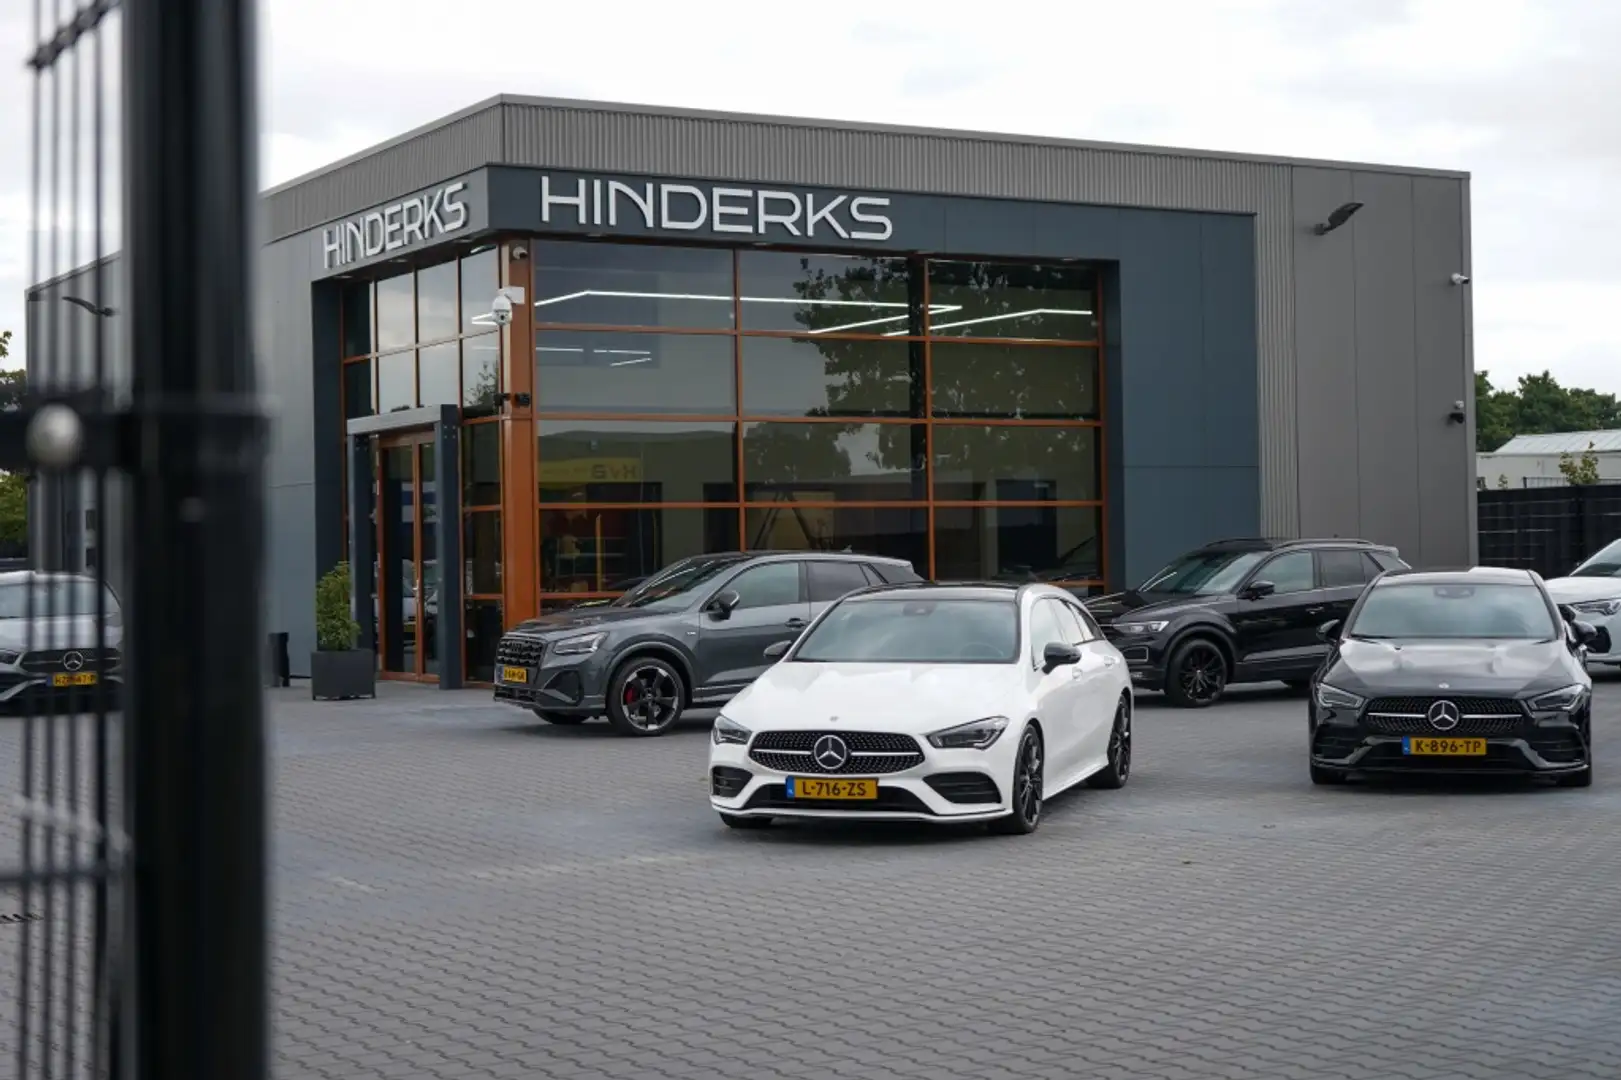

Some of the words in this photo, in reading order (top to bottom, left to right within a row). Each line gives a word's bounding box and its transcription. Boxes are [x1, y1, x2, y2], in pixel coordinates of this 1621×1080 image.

[323, 182, 467, 269] HINDERKS
[541, 175, 893, 241] HINDERKS
[1415, 740, 1482, 753] K-896-TP
[801, 781, 867, 797] L-716-ZS
